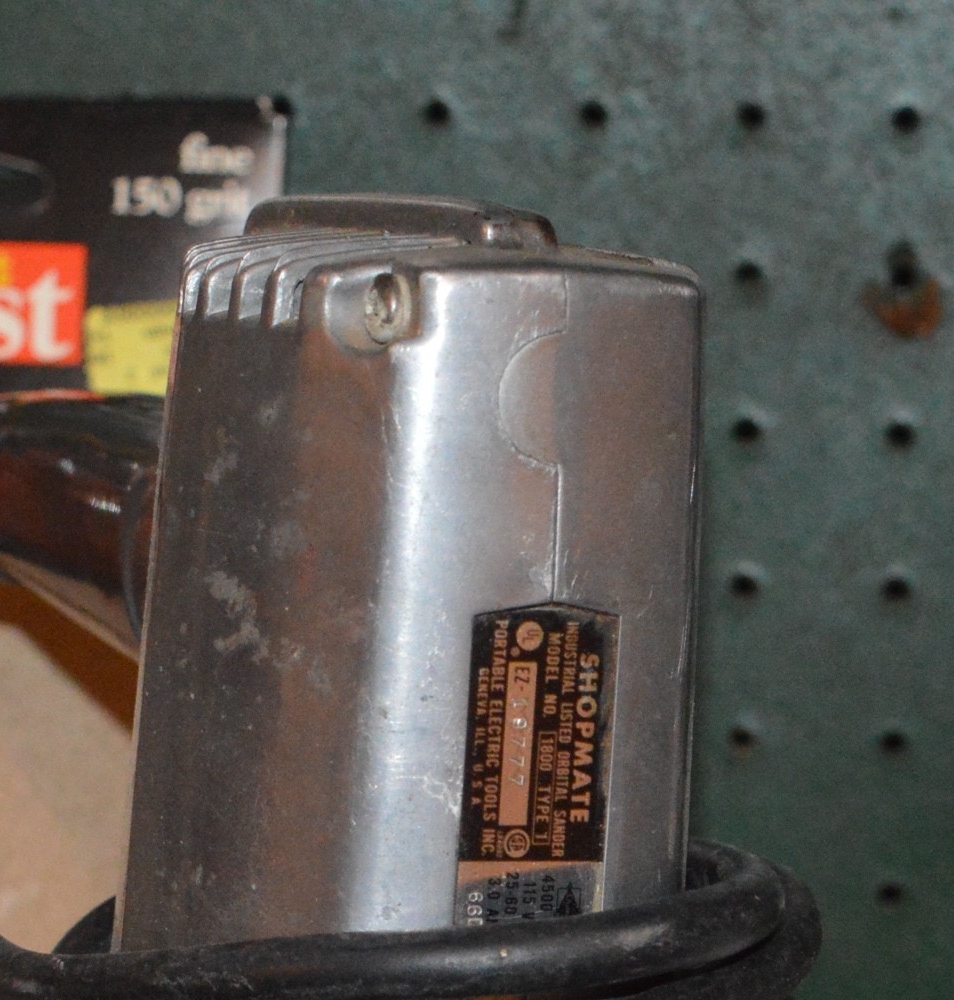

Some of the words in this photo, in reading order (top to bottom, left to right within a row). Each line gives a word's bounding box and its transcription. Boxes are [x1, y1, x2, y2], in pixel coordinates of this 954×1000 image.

[179, 131, 254, 175] fine
[112, 176, 183, 217] 150
[490, 619, 510, 692] PORTABLE
[546, 632, 562, 683] MODEL
[561, 621, 580, 694] INDUSTRIAL
[485, 699, 504, 768] ELECTRIC
[558, 702, 575, 744] LISTED
[568, 653, 601, 823] SHOPMATE
[539, 739, 554, 772] 1800
[554, 751, 571, 802] ORBITAL
[482, 775, 499, 822] TOOLS
[535, 786, 551, 823] TYPE
[480, 828, 496, 857] INC.
[551, 809, 567, 858] SANDER
[486, 877, 503, 900] 3.0
[504, 871, 521, 916] 25-60
[522, 882, 537, 905] 115
[539, 873, 556, 912] 4500
